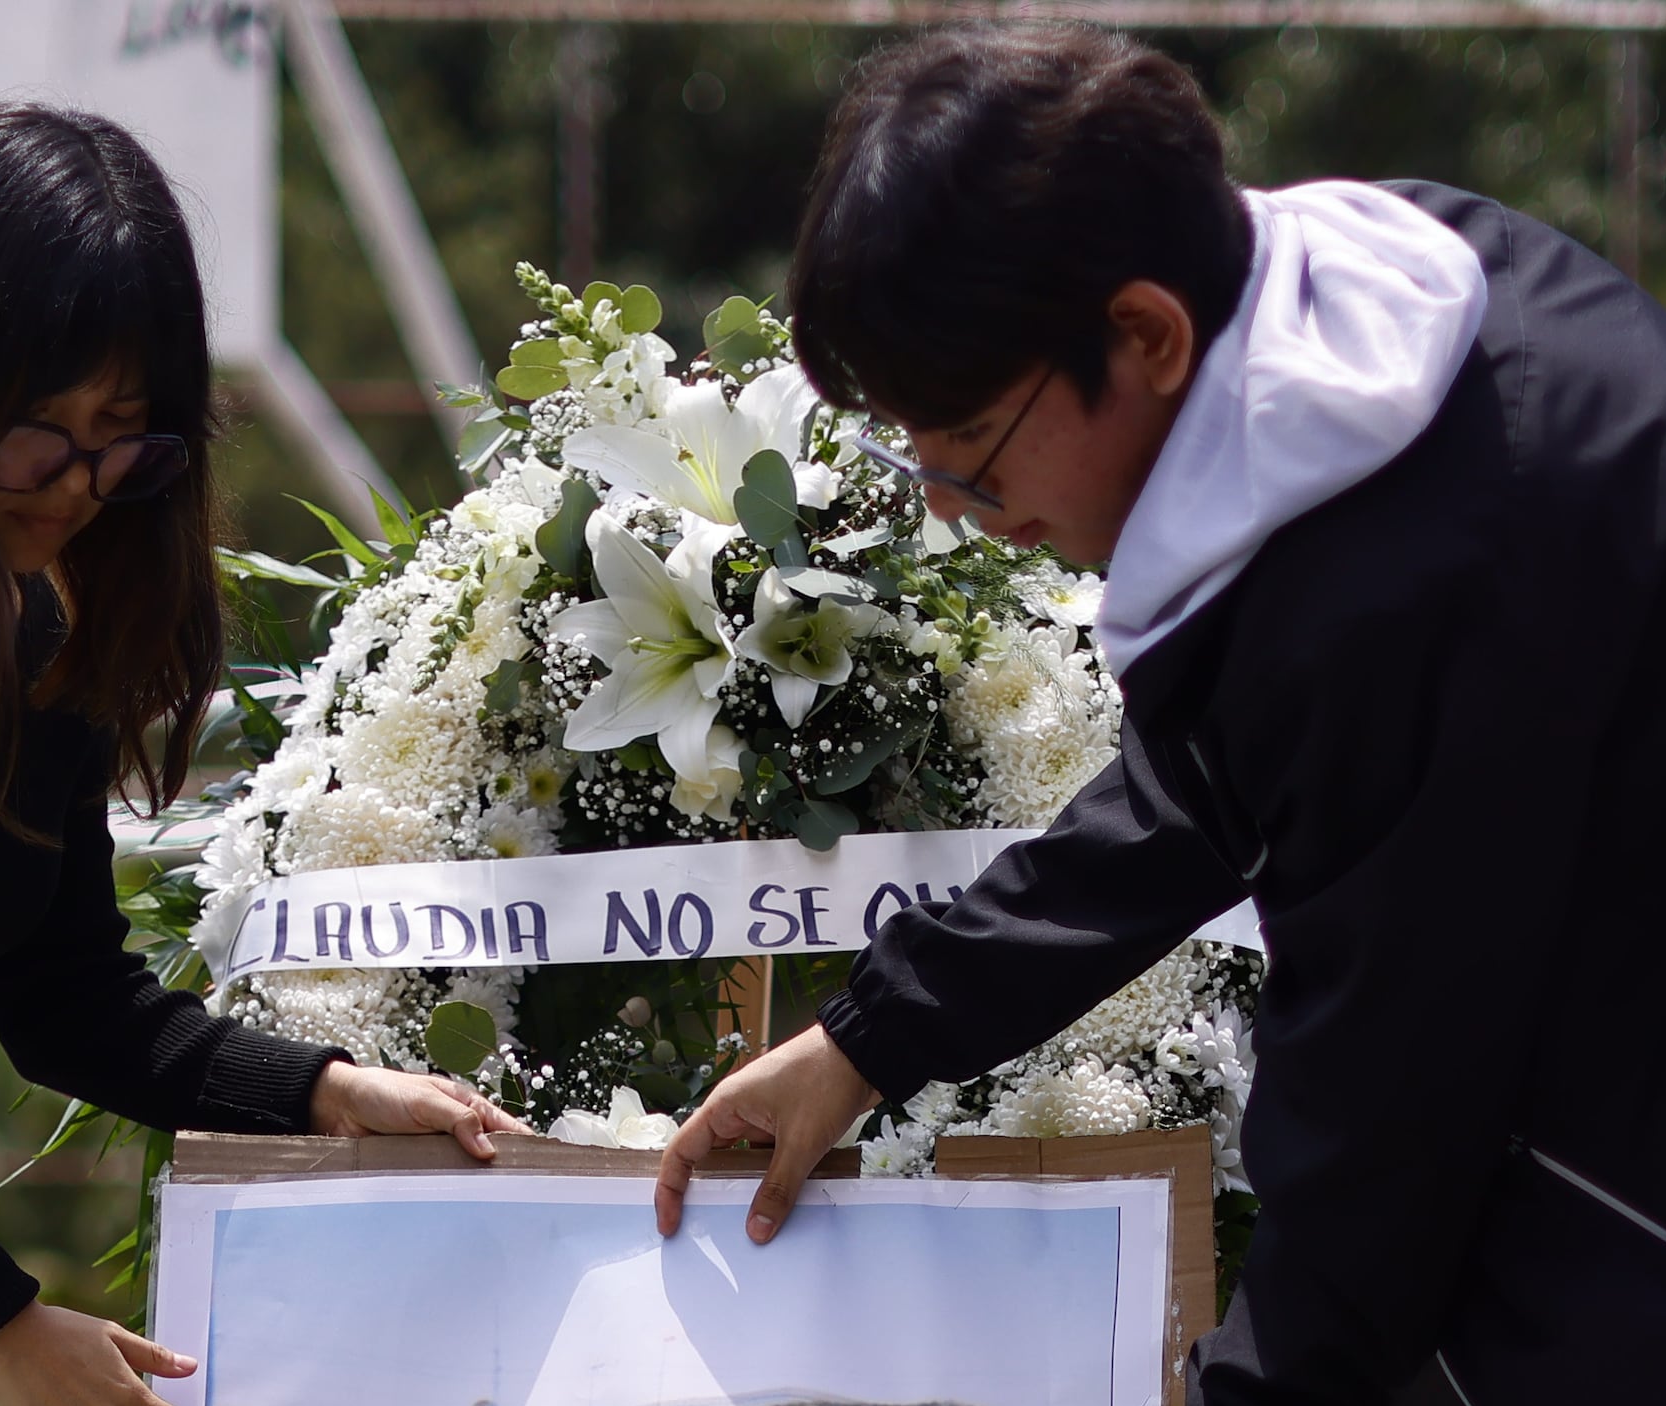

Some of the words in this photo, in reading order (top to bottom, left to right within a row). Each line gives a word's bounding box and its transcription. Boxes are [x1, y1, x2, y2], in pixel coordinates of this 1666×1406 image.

[223, 898, 550, 972] CLAUDIA
[603, 888, 714, 958] NO
[747, 883, 838, 948] SE
